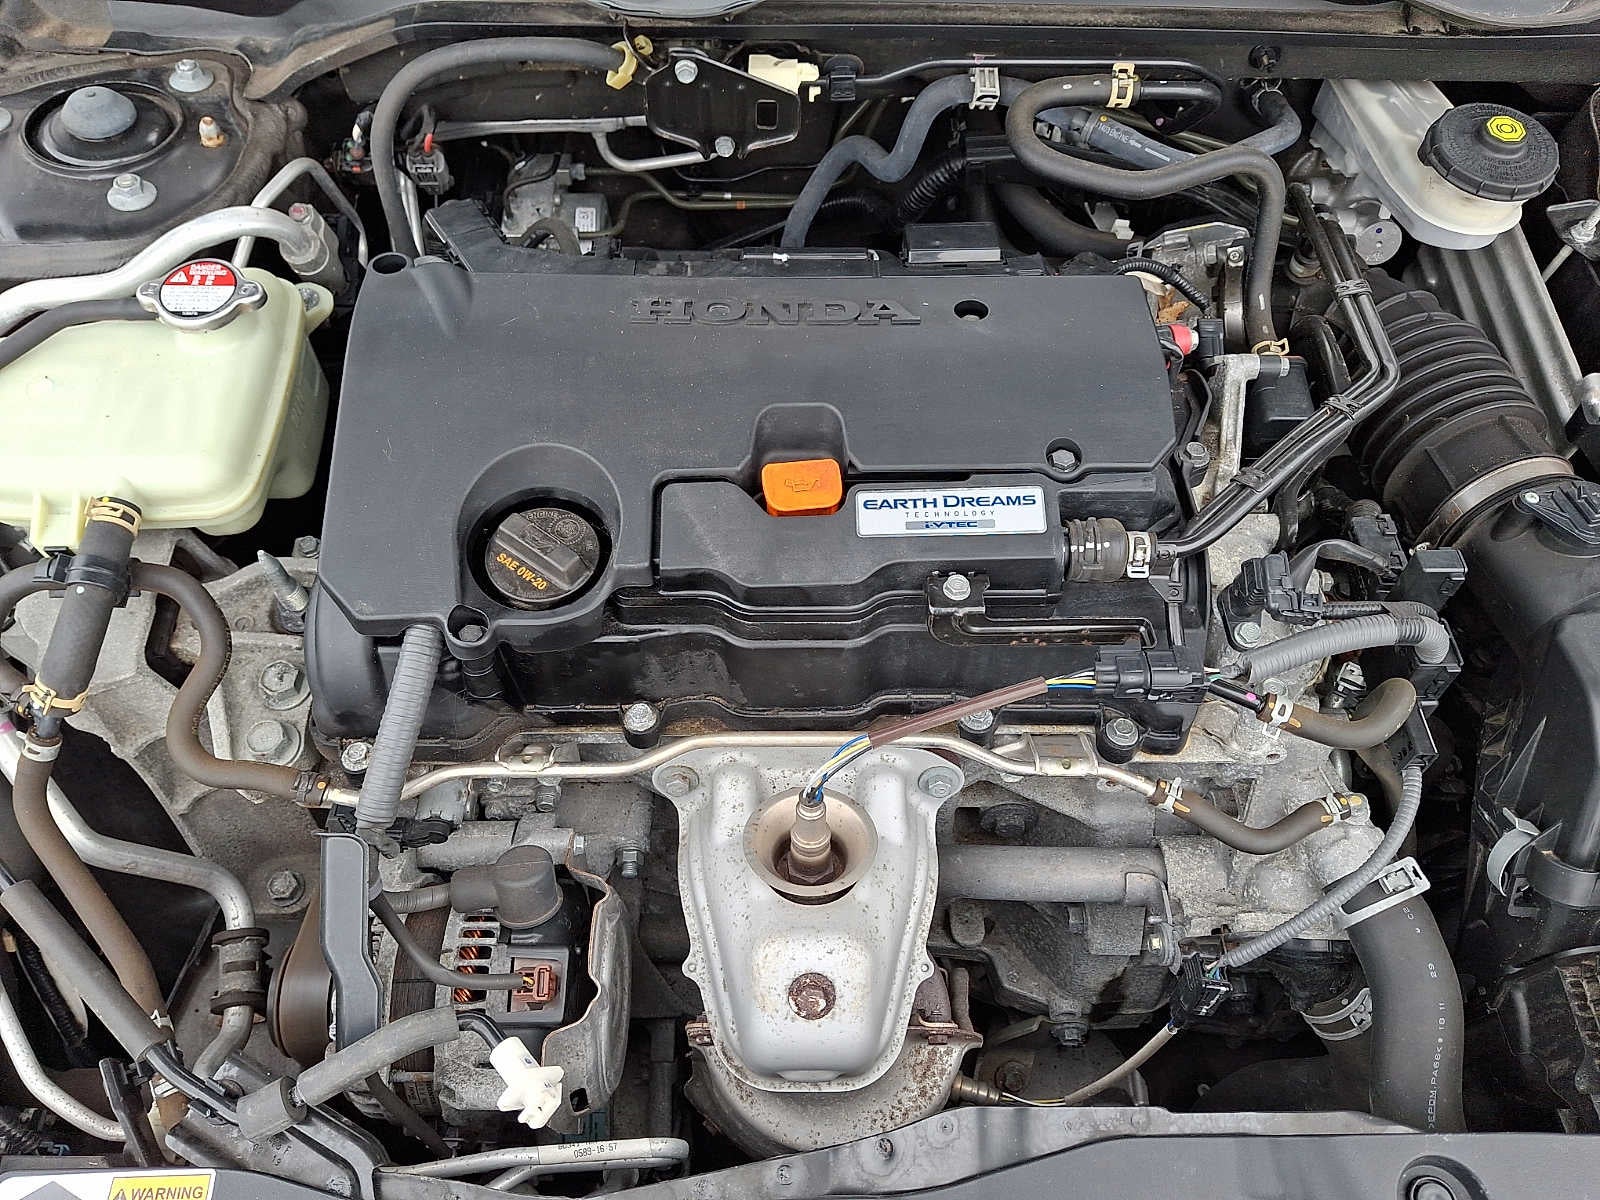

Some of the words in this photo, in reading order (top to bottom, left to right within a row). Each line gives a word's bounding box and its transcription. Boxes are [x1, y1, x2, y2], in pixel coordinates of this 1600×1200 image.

[631, 297, 921, 325] HONDA
[862, 498, 938, 511] EARTH
[942, 495, 1037, 507] DREAMS
[905, 510, 995, 518] TECHNOLOGY
[496, 552, 520, 571] SAE
[516, 566, 548, 590] 0W-20
[131, 1186, 204, 1200] WARNING
